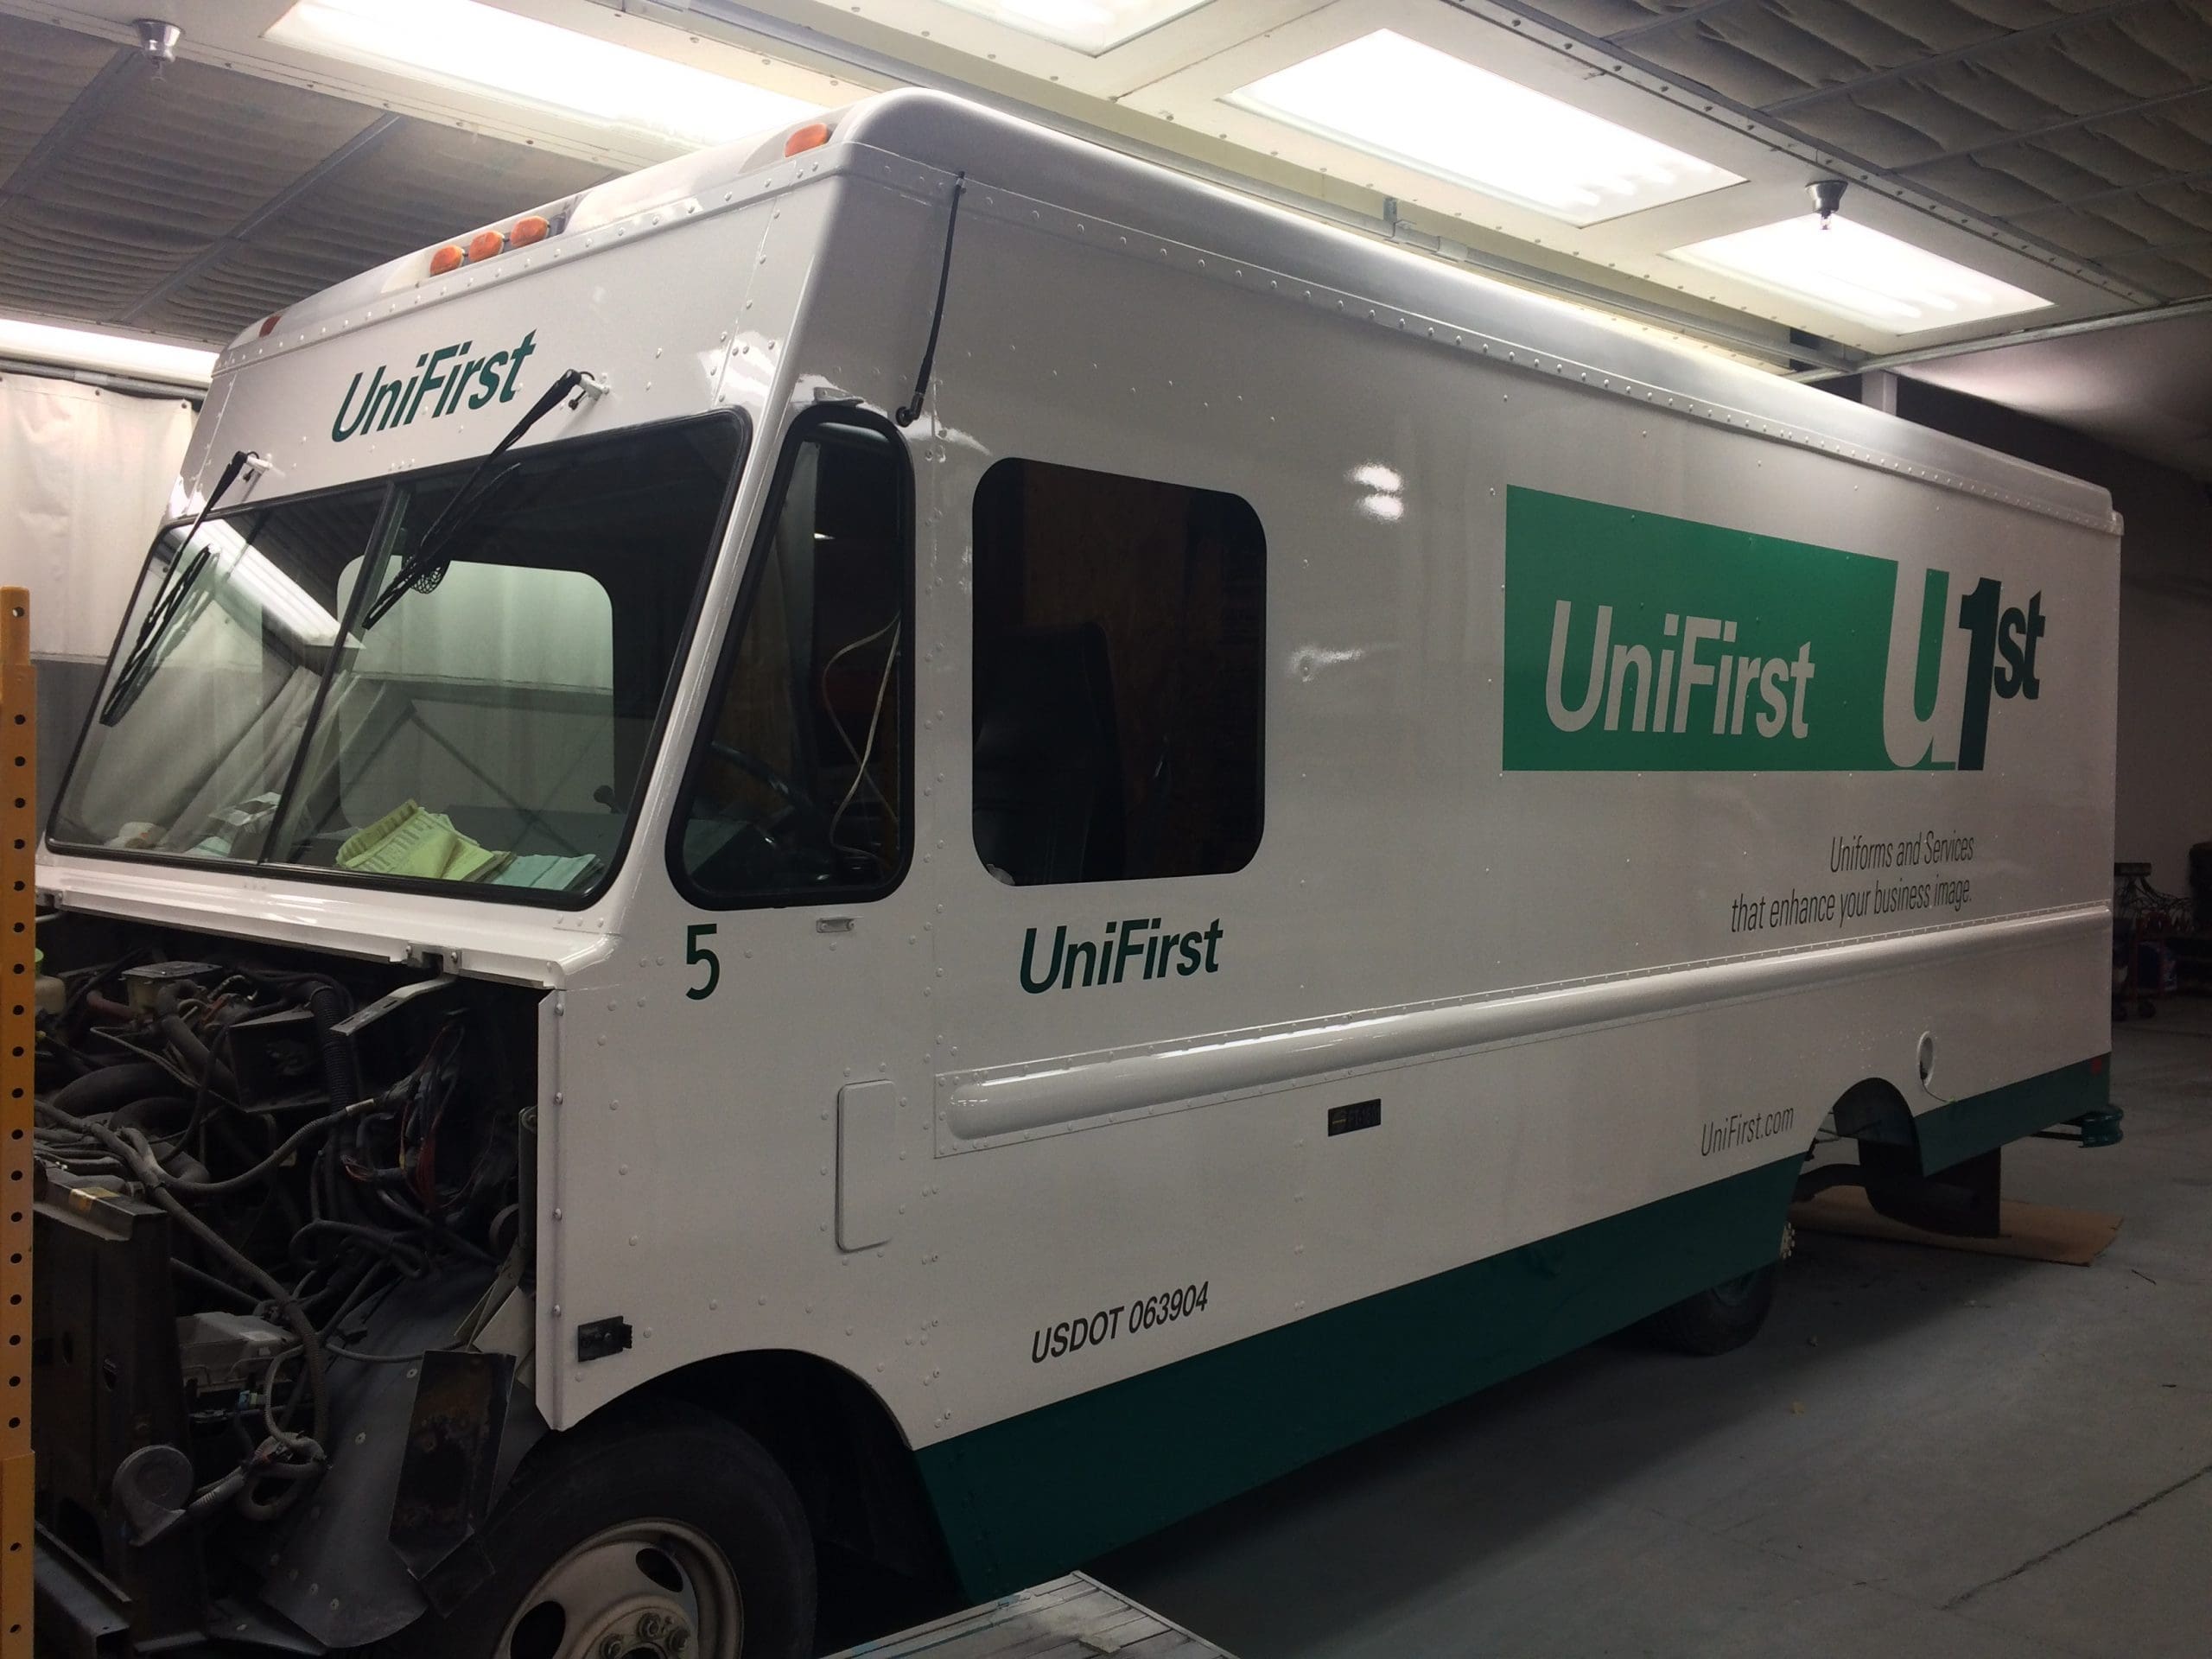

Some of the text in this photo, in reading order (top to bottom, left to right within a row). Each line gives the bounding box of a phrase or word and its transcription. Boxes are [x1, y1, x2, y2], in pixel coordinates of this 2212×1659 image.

[332, 330, 537, 442] UniFirst
[1546, 599, 1815, 739] UniFirst
[1830, 830, 1975, 873] Uniforms and Services
[1731, 874, 1973, 933] that enhance your business image.
[686, 924, 721, 1001] 5
[1020, 918, 1224, 995] UniFirst
[1700, 1107, 1795, 1157] UniFirst.com
[1032, 1281, 1209, 1363] USDOT 063904
